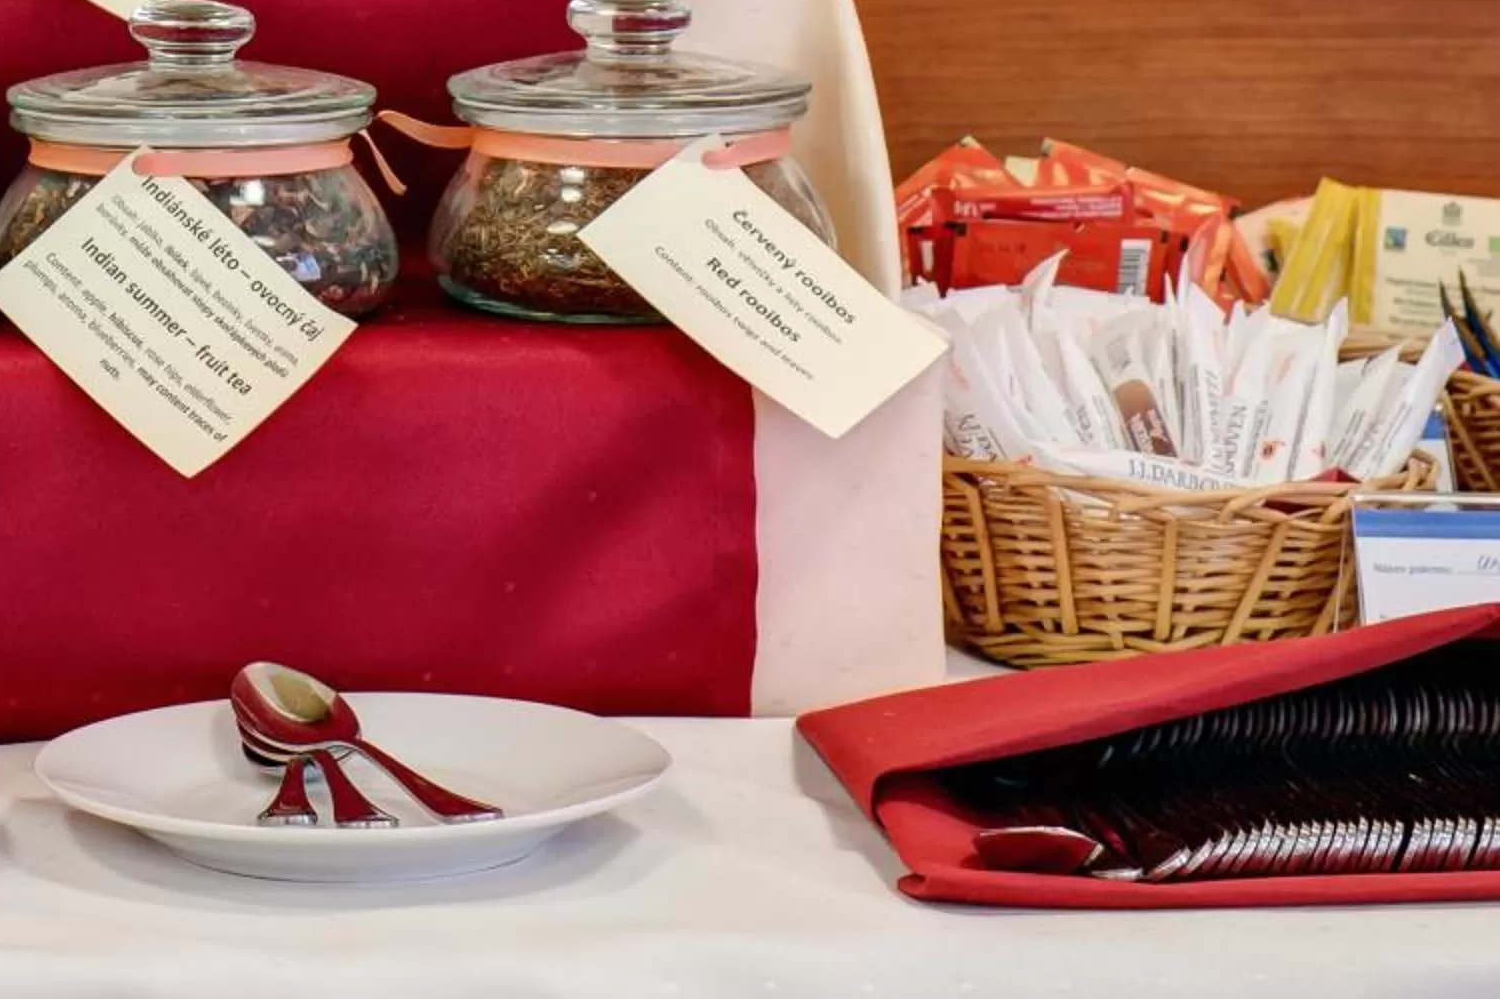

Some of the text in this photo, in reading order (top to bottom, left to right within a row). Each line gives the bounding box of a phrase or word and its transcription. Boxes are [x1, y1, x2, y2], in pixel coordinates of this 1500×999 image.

[80, 236, 127, 284] Indian
[124, 281, 187, 337] summer
[194, 343, 229, 378] fruit
[225, 371, 252, 395] tea
[140, 174, 212, 242] Indiánské
[207, 236, 240, 270] léto
[249, 279, 306, 326] ovocný
[298, 318, 325, 342] čaj
[705, 256, 800, 342] Red rooibos
[731, 209, 855, 324] Červený rooibos
